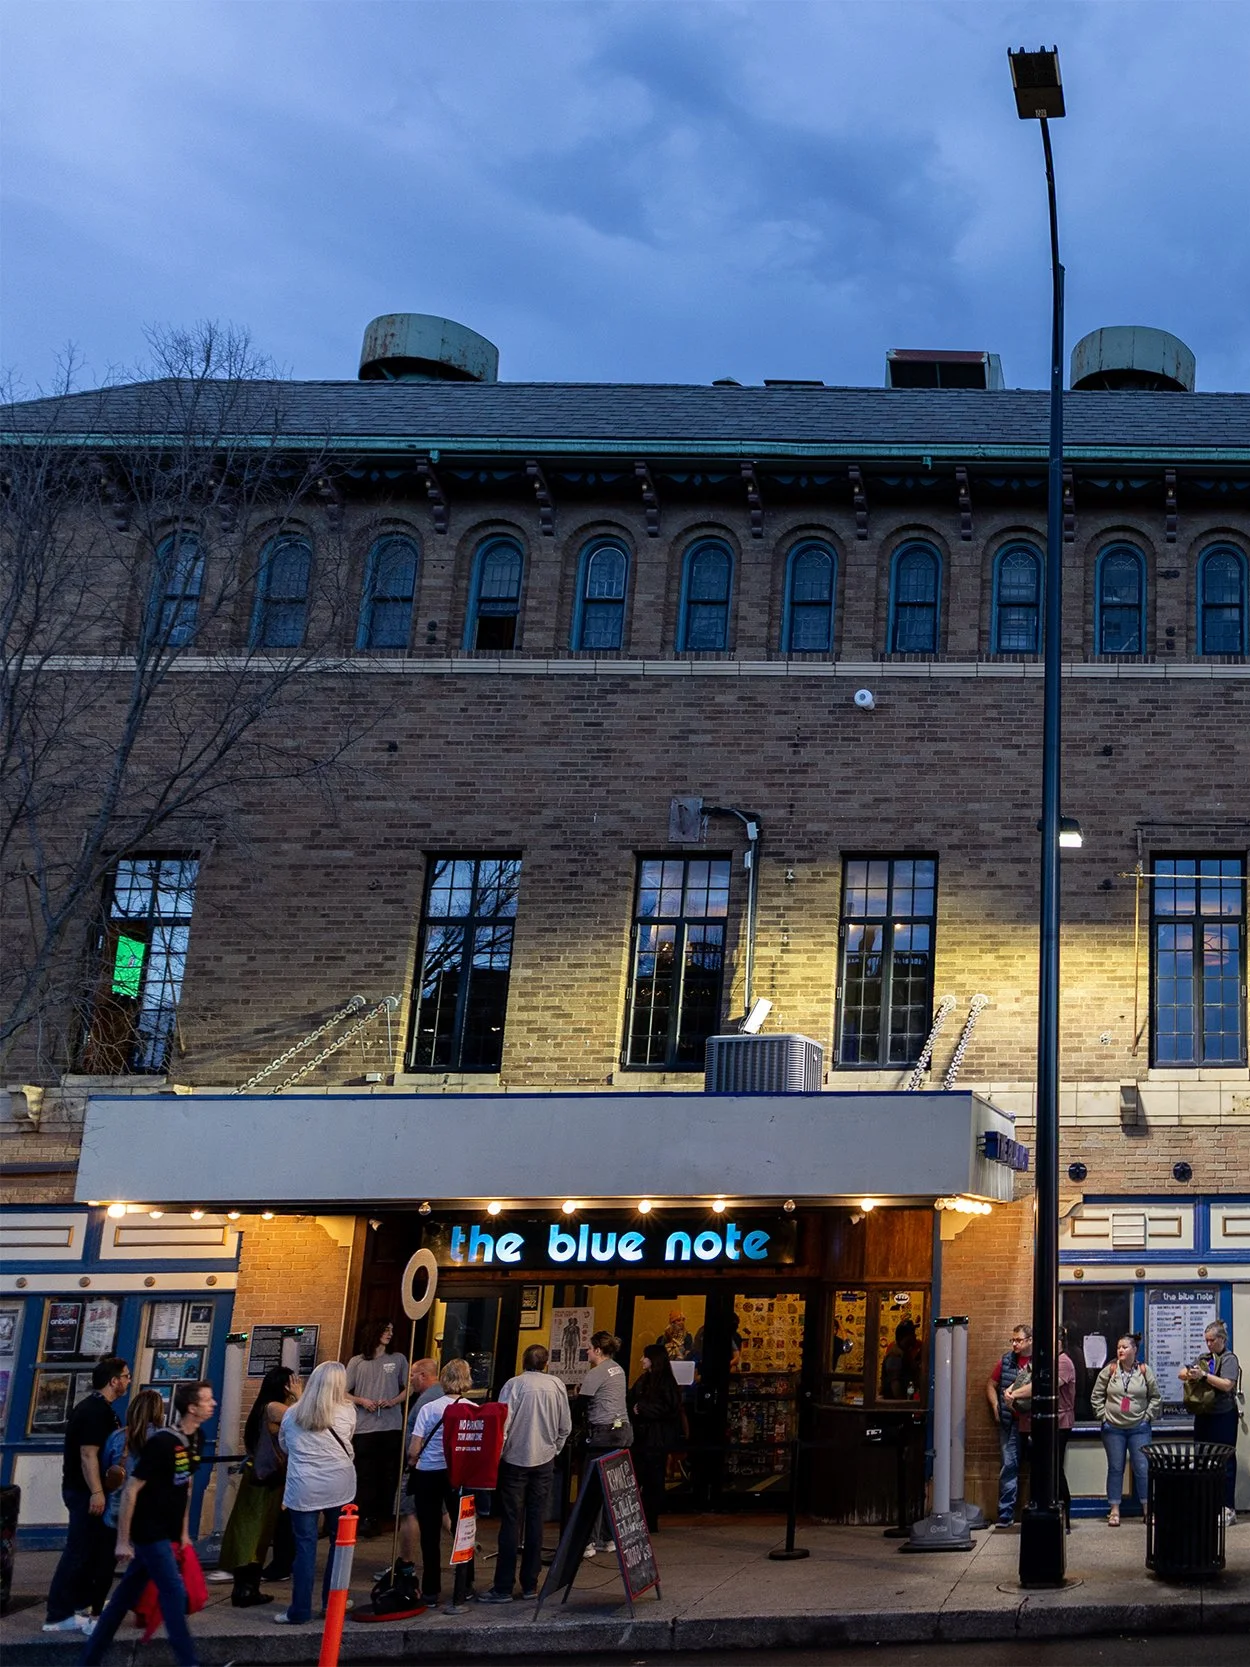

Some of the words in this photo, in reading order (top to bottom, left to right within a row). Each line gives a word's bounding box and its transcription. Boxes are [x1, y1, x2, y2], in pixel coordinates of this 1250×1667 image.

[450, 1224, 525, 1263] the
[548, 1223, 646, 1262] blue
[664, 1222, 771, 1261] note
[1163, 1292, 1177, 1301] the
[1178, 1291, 1195, 1301] blue
[1196, 1292, 1214, 1301] note
